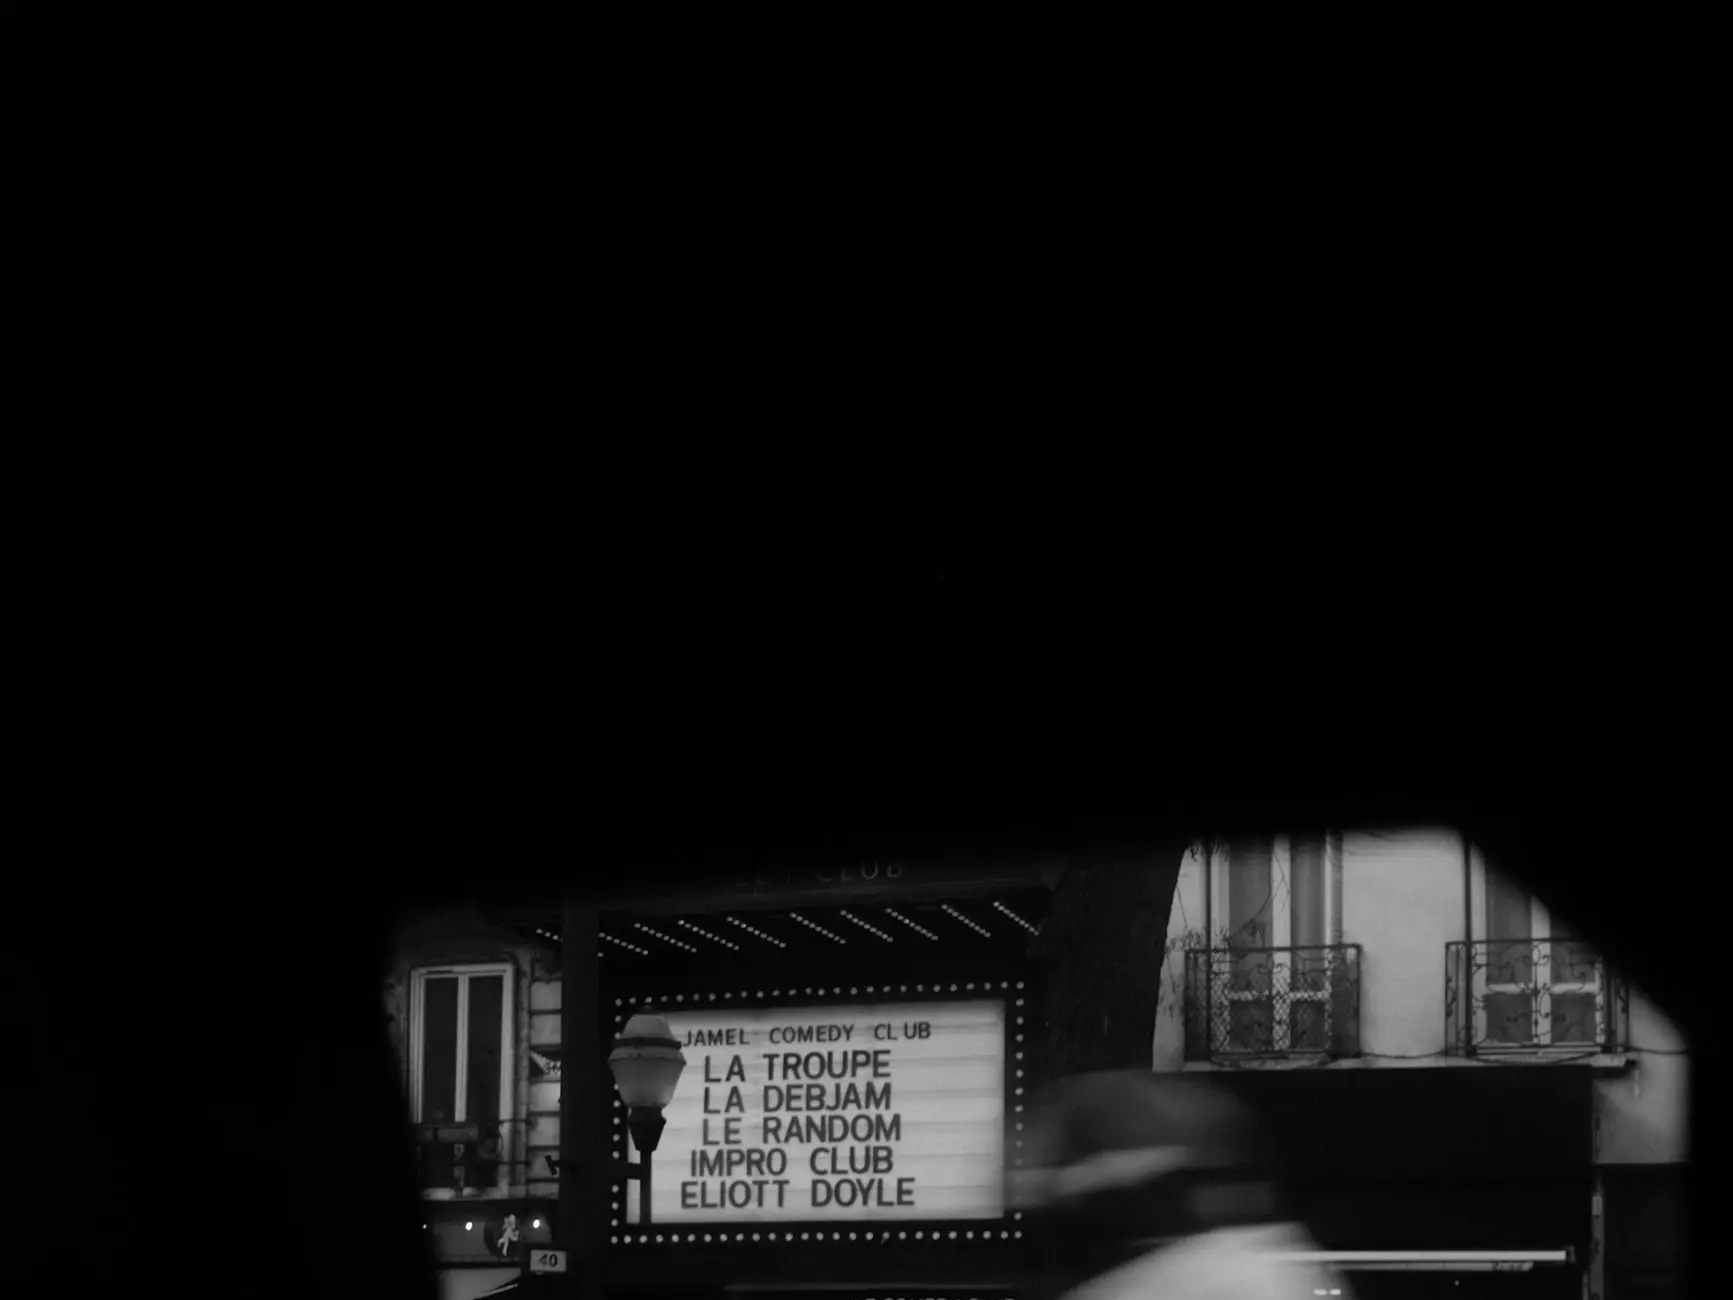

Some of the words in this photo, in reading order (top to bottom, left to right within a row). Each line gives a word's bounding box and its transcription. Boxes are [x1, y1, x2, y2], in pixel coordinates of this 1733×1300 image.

[683, 1028, 751, 1047] JAMEL
[768, 1024, 855, 1044] COMEDY
[874, 1021, 931, 1040] CLUB
[704, 1054, 747, 1083] LA
[762, 1050, 892, 1081] TROUPE
[703, 1086, 745, 1114] LA
[762, 1082, 892, 1112] DEBJAM
[703, 1118, 743, 1146] LE
[762, 1114, 901, 1144] RANDOM
[690, 1148, 788, 1177] IMPRO
[809, 1146, 894, 1175] CLUB
[681, 1179, 790, 1209] ELIOTT
[811, 1177, 915, 1208] DOYLE
[539, 1253, 558, 1268] 40
